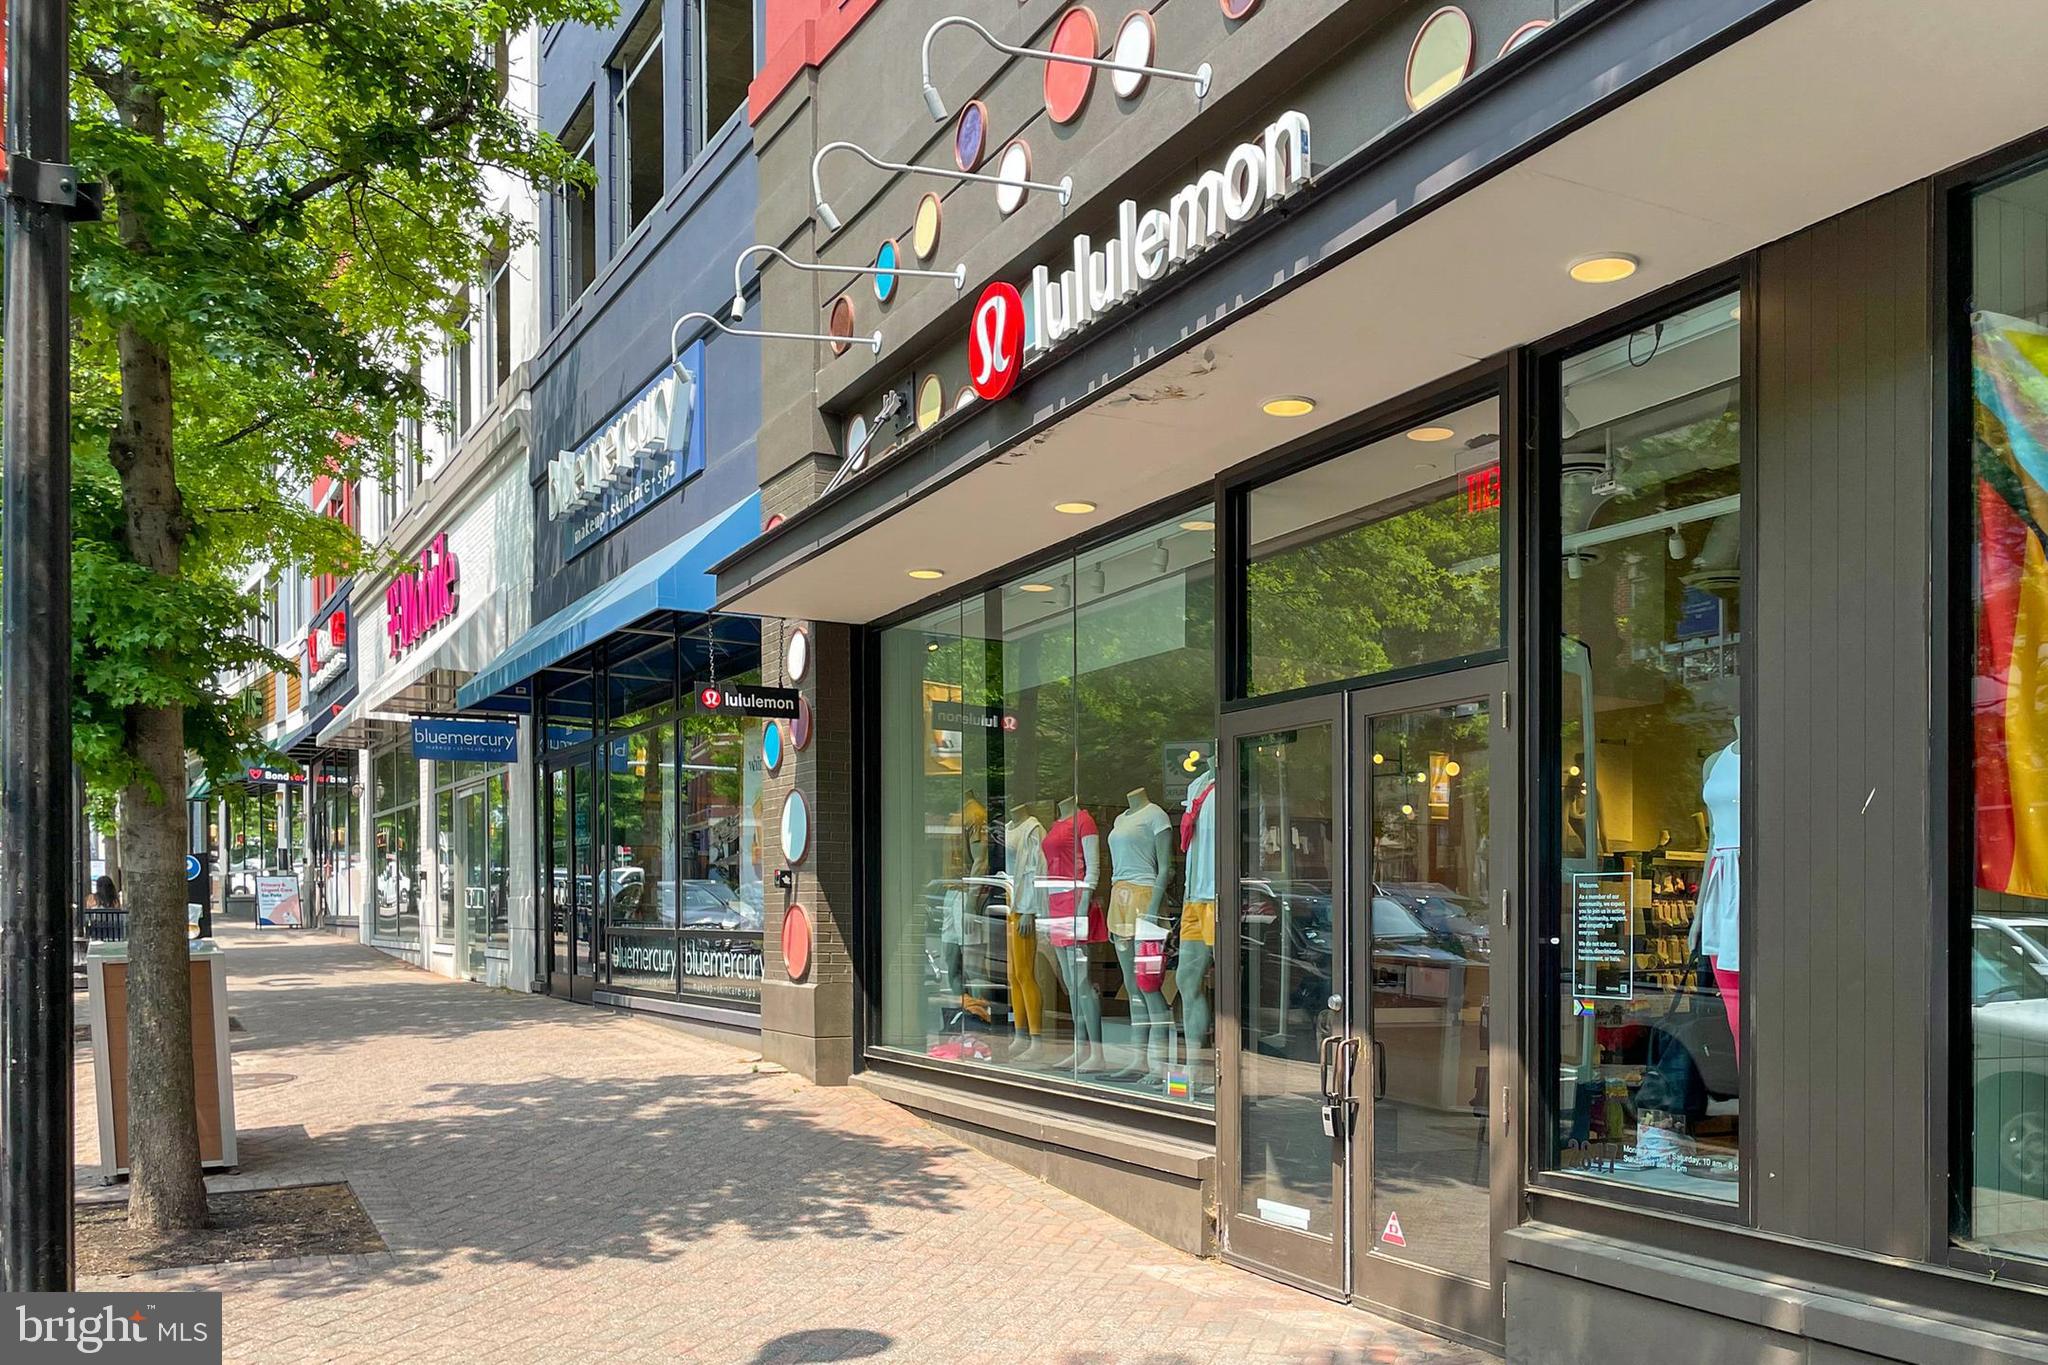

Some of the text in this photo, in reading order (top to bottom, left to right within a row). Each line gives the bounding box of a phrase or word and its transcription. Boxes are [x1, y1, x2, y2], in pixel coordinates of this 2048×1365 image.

[1032, 110, 1311, 352] lululemon
[611, 478, 650, 517] skincare
[657, 460, 676, 488] spa
[724, 691, 795, 710] lululemon
[414, 727, 514, 751] bluemercury
[265, 771, 289, 780] Bond
[613, 935, 677, 981] bluemercury
[685, 939, 765, 983] bluemercury
[1703, 1158, 1711, 1166] 10
